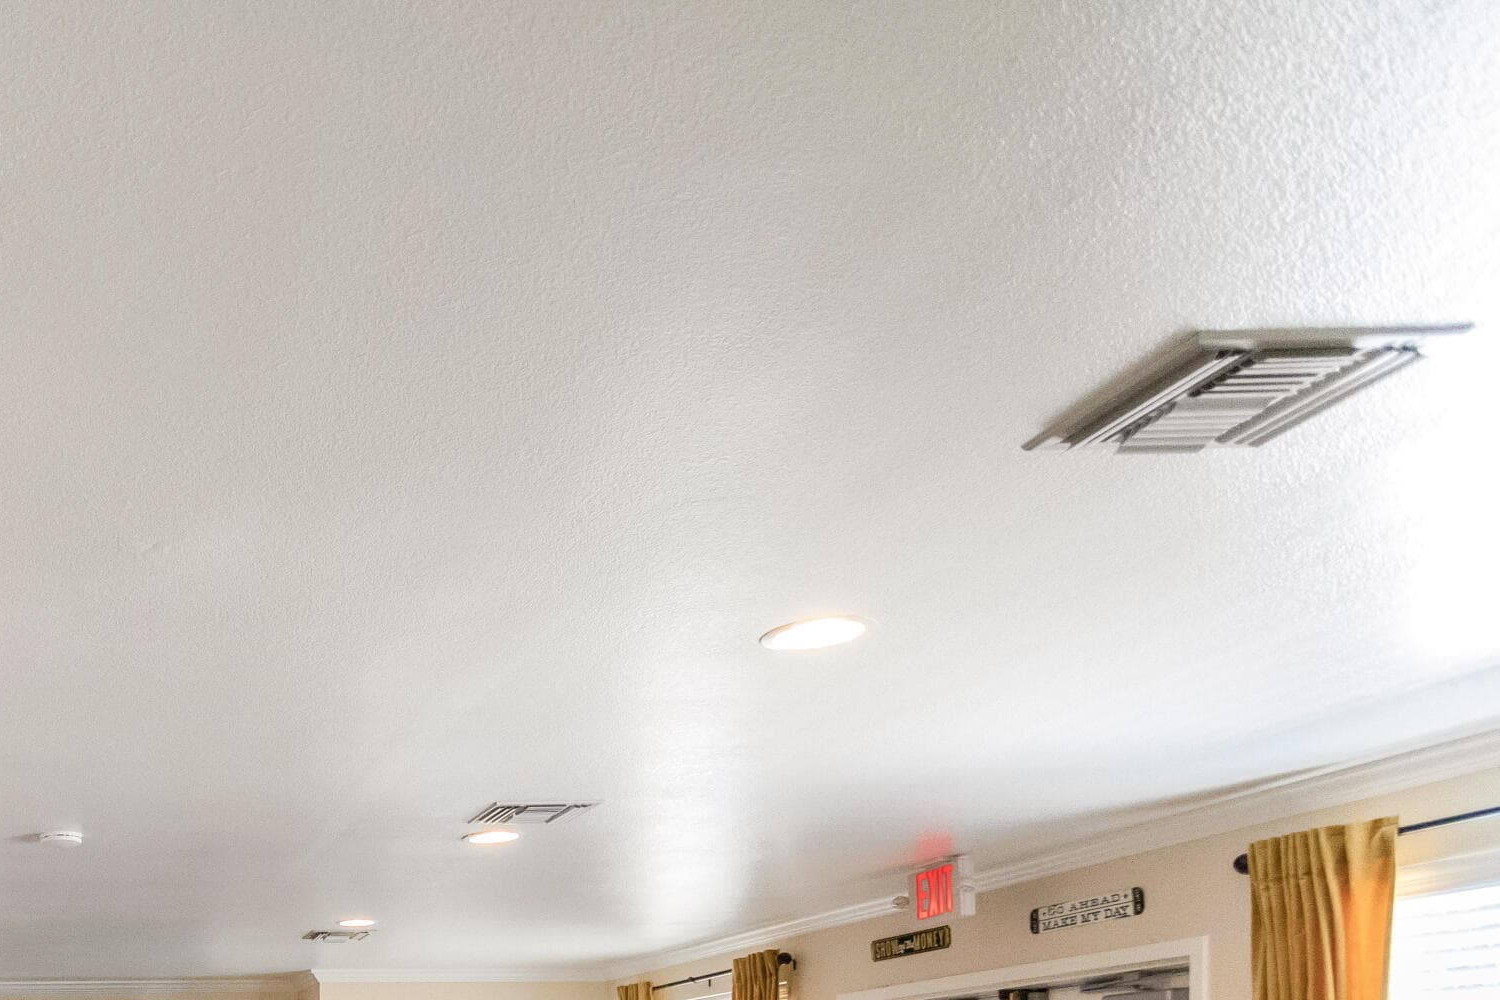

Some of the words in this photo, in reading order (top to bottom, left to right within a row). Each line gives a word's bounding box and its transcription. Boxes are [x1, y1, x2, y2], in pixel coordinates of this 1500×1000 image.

[916, 863, 954, 921] EXIT
[1069, 893, 1121, 912] AHEAD
[1042, 915, 1077, 932] MAKE
[1080, 911, 1101, 924] MY
[1103, 905, 1130, 919] DAY
